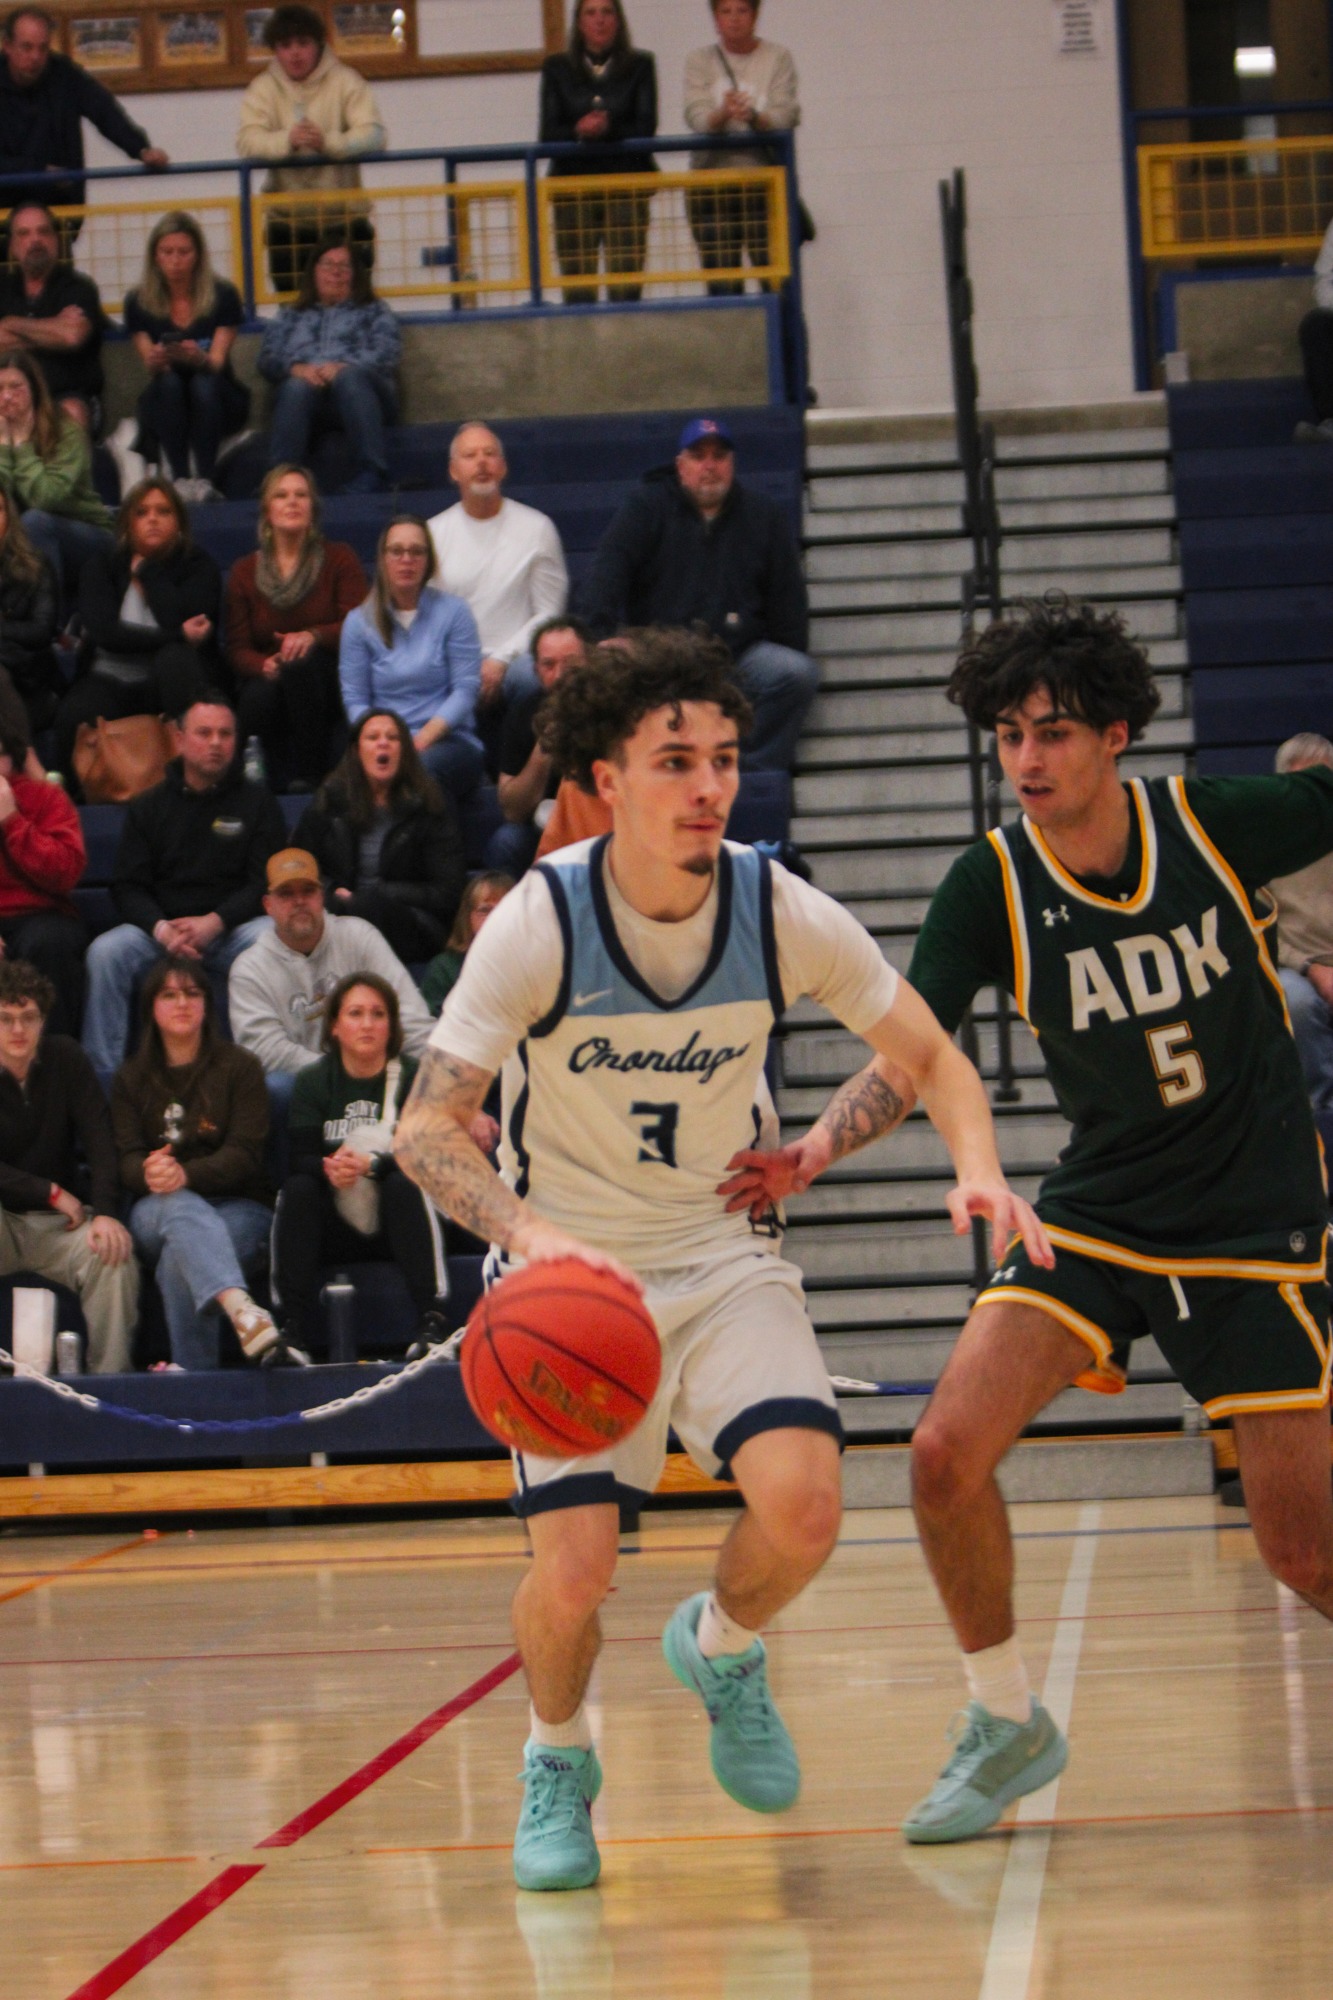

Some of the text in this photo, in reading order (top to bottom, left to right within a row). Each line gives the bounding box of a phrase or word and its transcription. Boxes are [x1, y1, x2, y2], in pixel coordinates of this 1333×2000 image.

[1064, 905, 1231, 1032] ADK
[1144, 1020, 1207, 1108] 5
[343, 1099, 380, 1119] SUNY
[629, 1100, 680, 1169] 3
